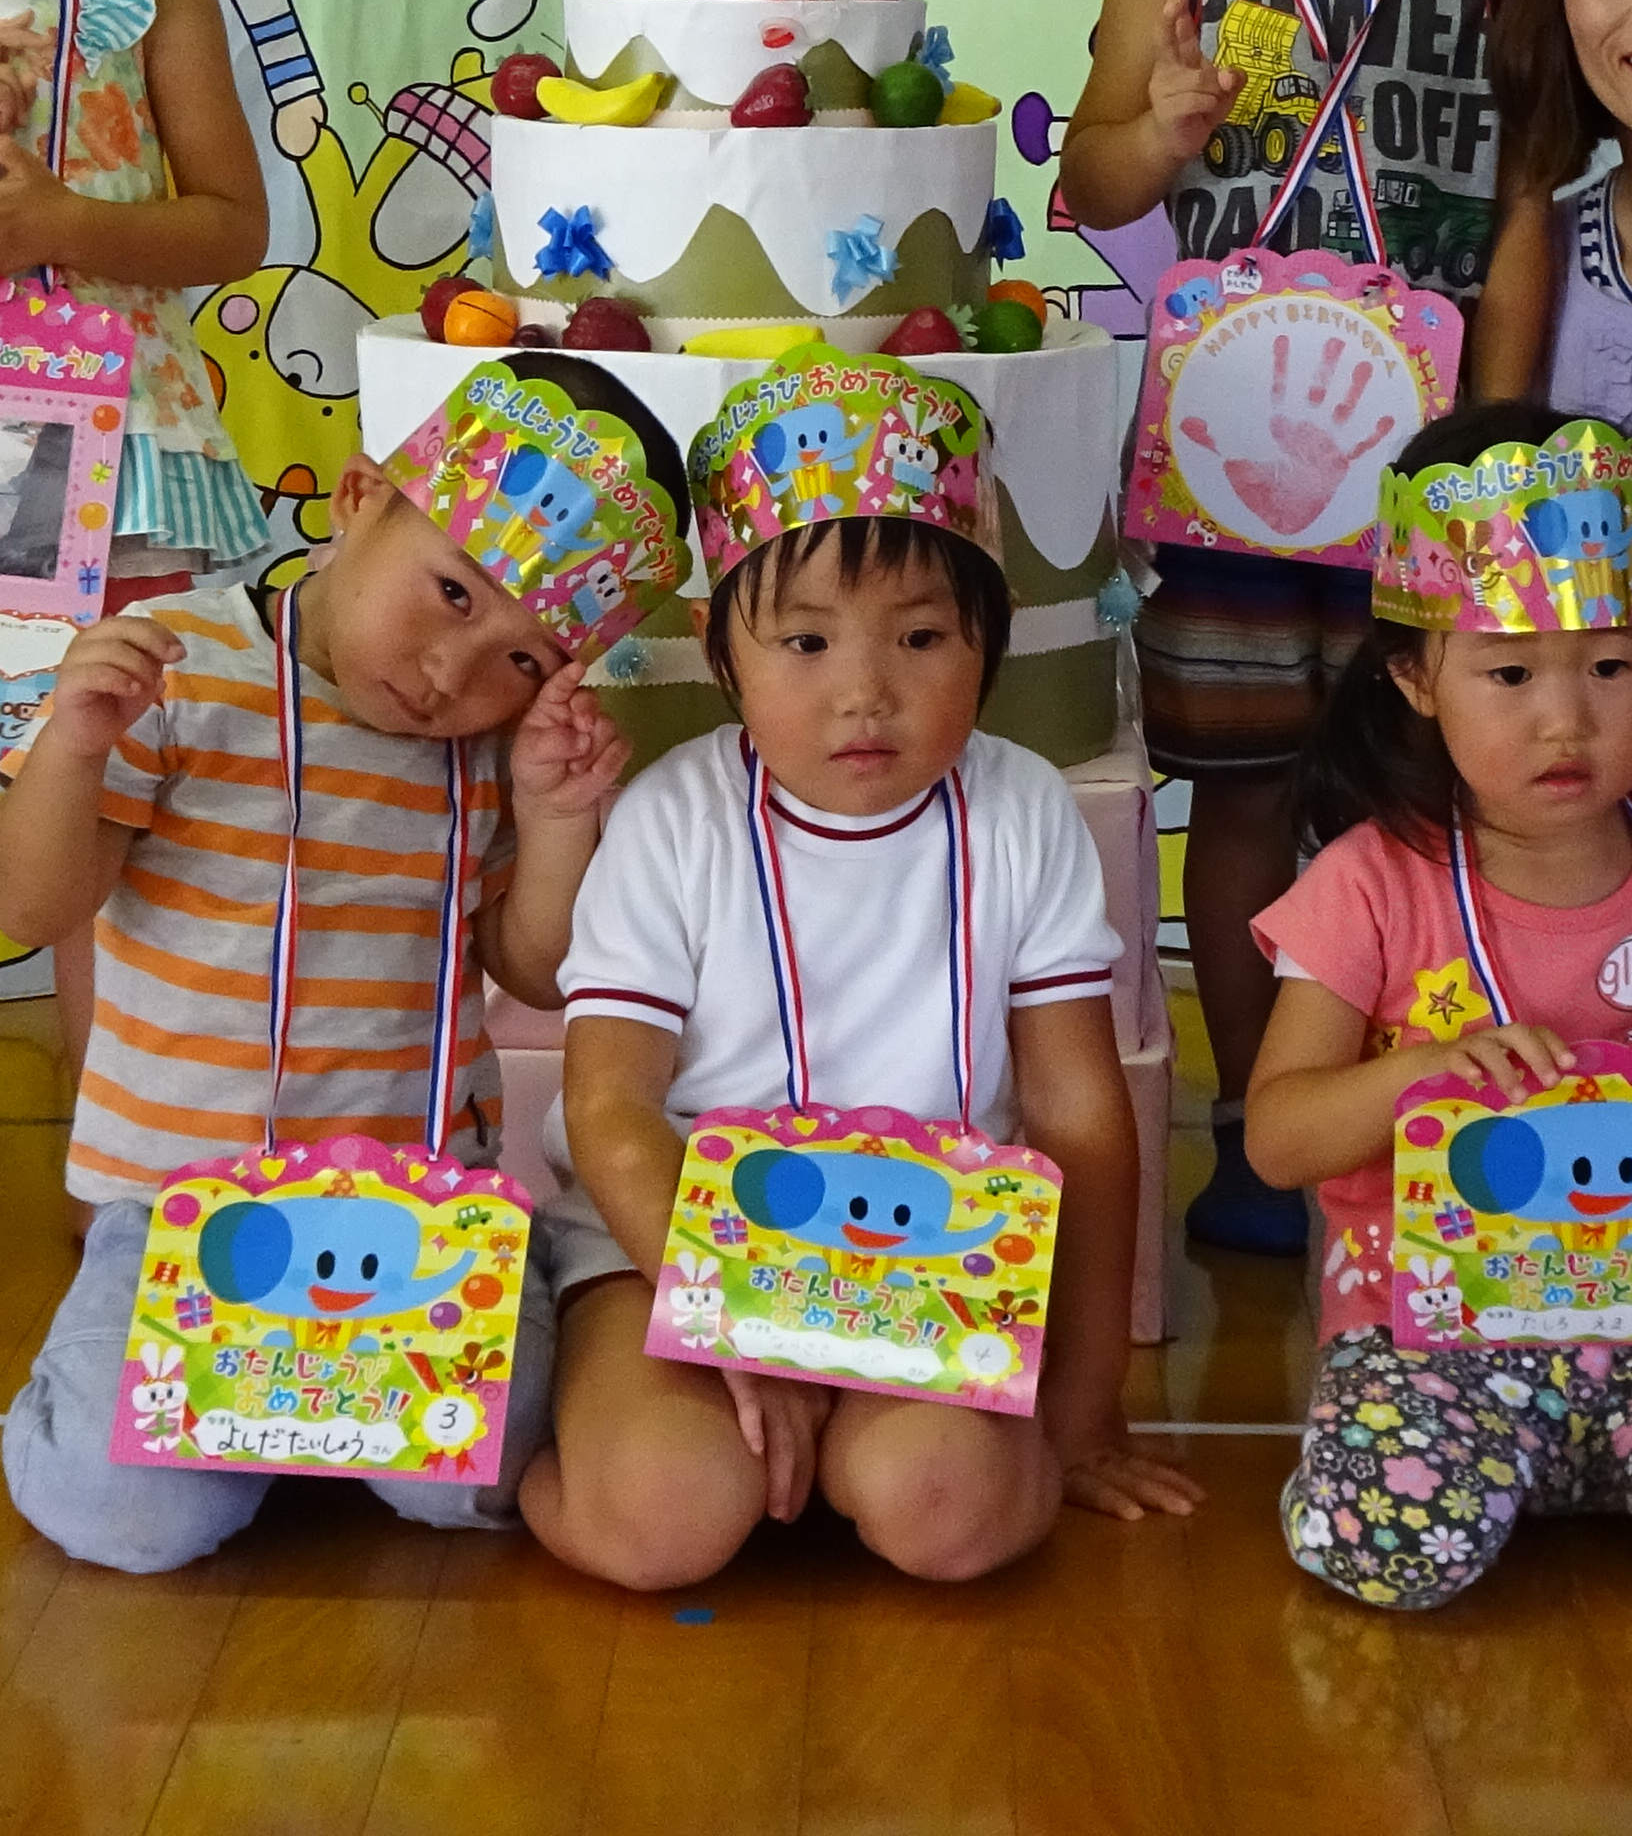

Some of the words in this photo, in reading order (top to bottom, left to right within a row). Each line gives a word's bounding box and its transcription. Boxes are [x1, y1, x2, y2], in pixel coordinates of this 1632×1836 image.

[1373, 80, 1501, 174] OFF
[1286, 303, 1397, 378] BIRTHDAY
[468, 377, 601, 458] おたんじょうび
[694, 374, 802, 479] おたんじょうび
[1426, 451, 1583, 512] おたんじょうび
[750, 1267, 927, 1313] おたんじょうび
[771, 1294, 948, 1347] おめでとう!!
[214, 1348, 391, 1384] おたんじょうび
[234, 1377, 413, 1422] おめでとう!!
[438, 1403, 459, 1430] 3
